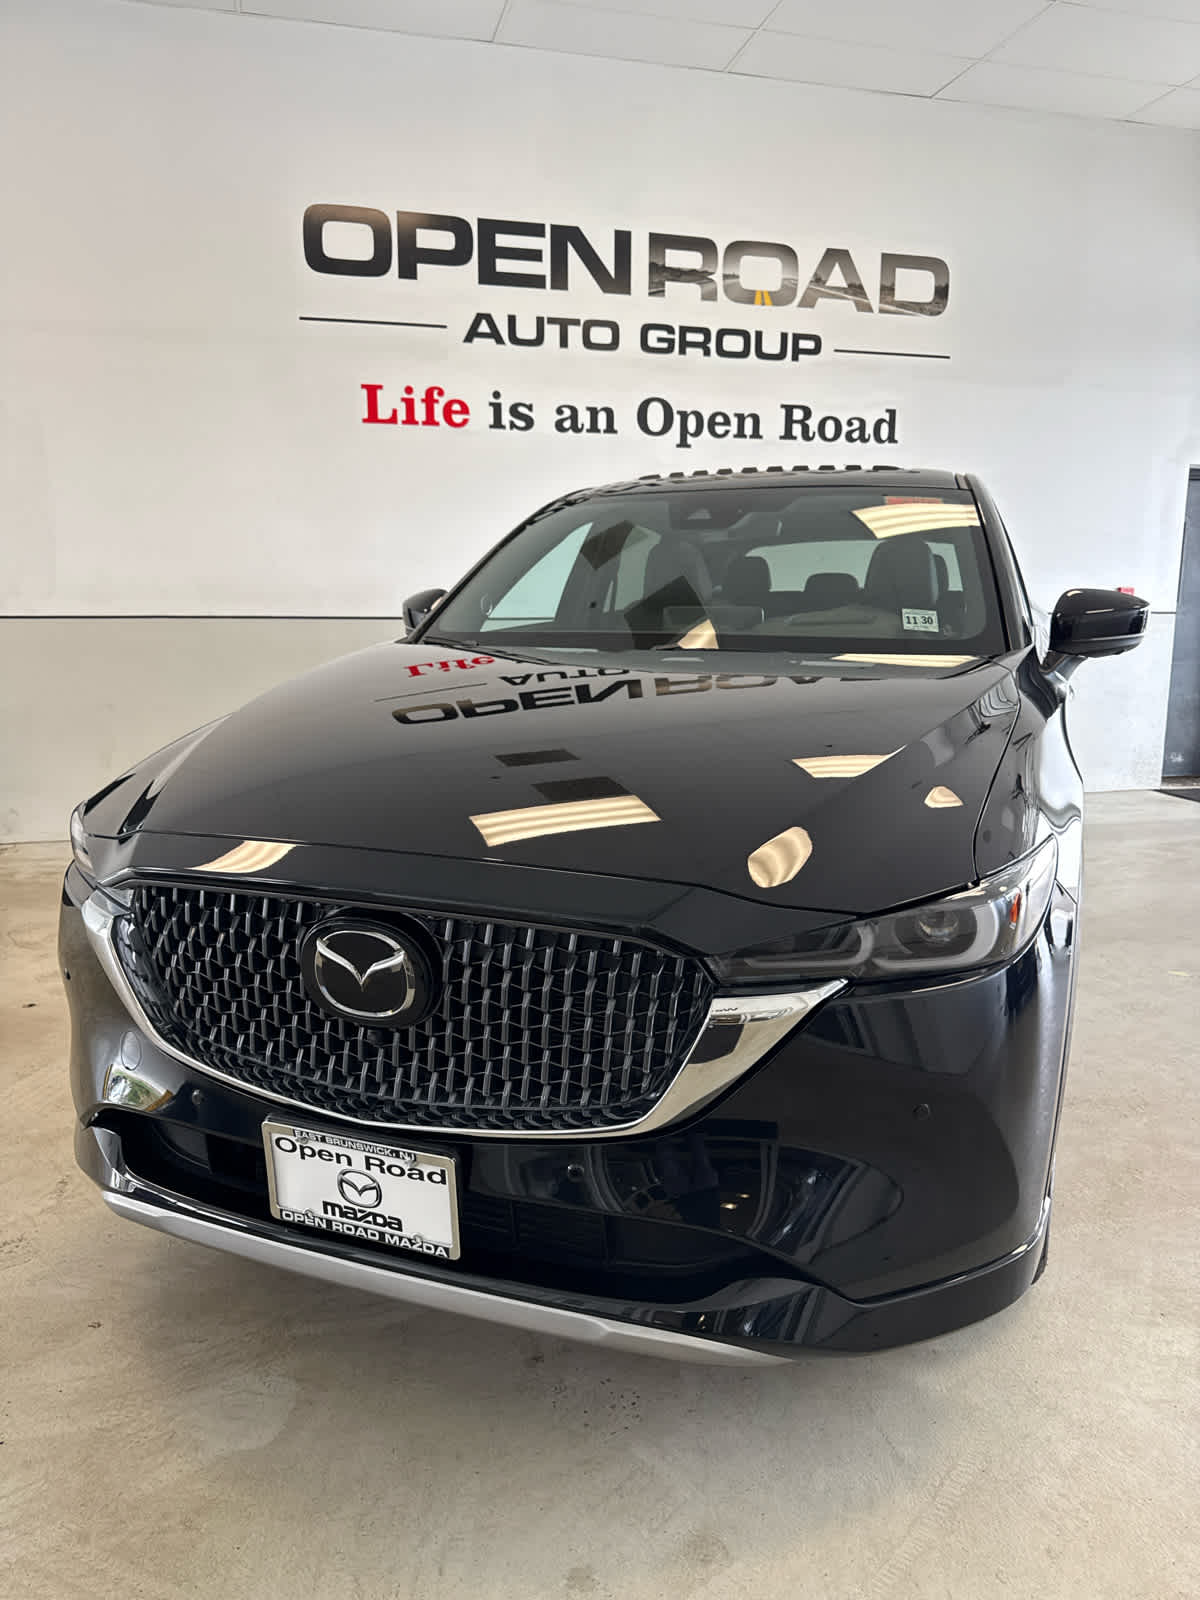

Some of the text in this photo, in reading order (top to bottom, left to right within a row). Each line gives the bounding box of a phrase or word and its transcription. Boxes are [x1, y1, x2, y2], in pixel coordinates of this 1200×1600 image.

[302, 203, 950, 317] OPEN ROAD
[463, 312, 823, 362] AUTO GROUP
[360, 383, 899, 449] Life is an Open Road
[906, 615, 934, 625] 11 30
[275, 1136, 447, 1185] Open Road
[281, 1209, 449, 1258] OPEN ROAD MAZDA
